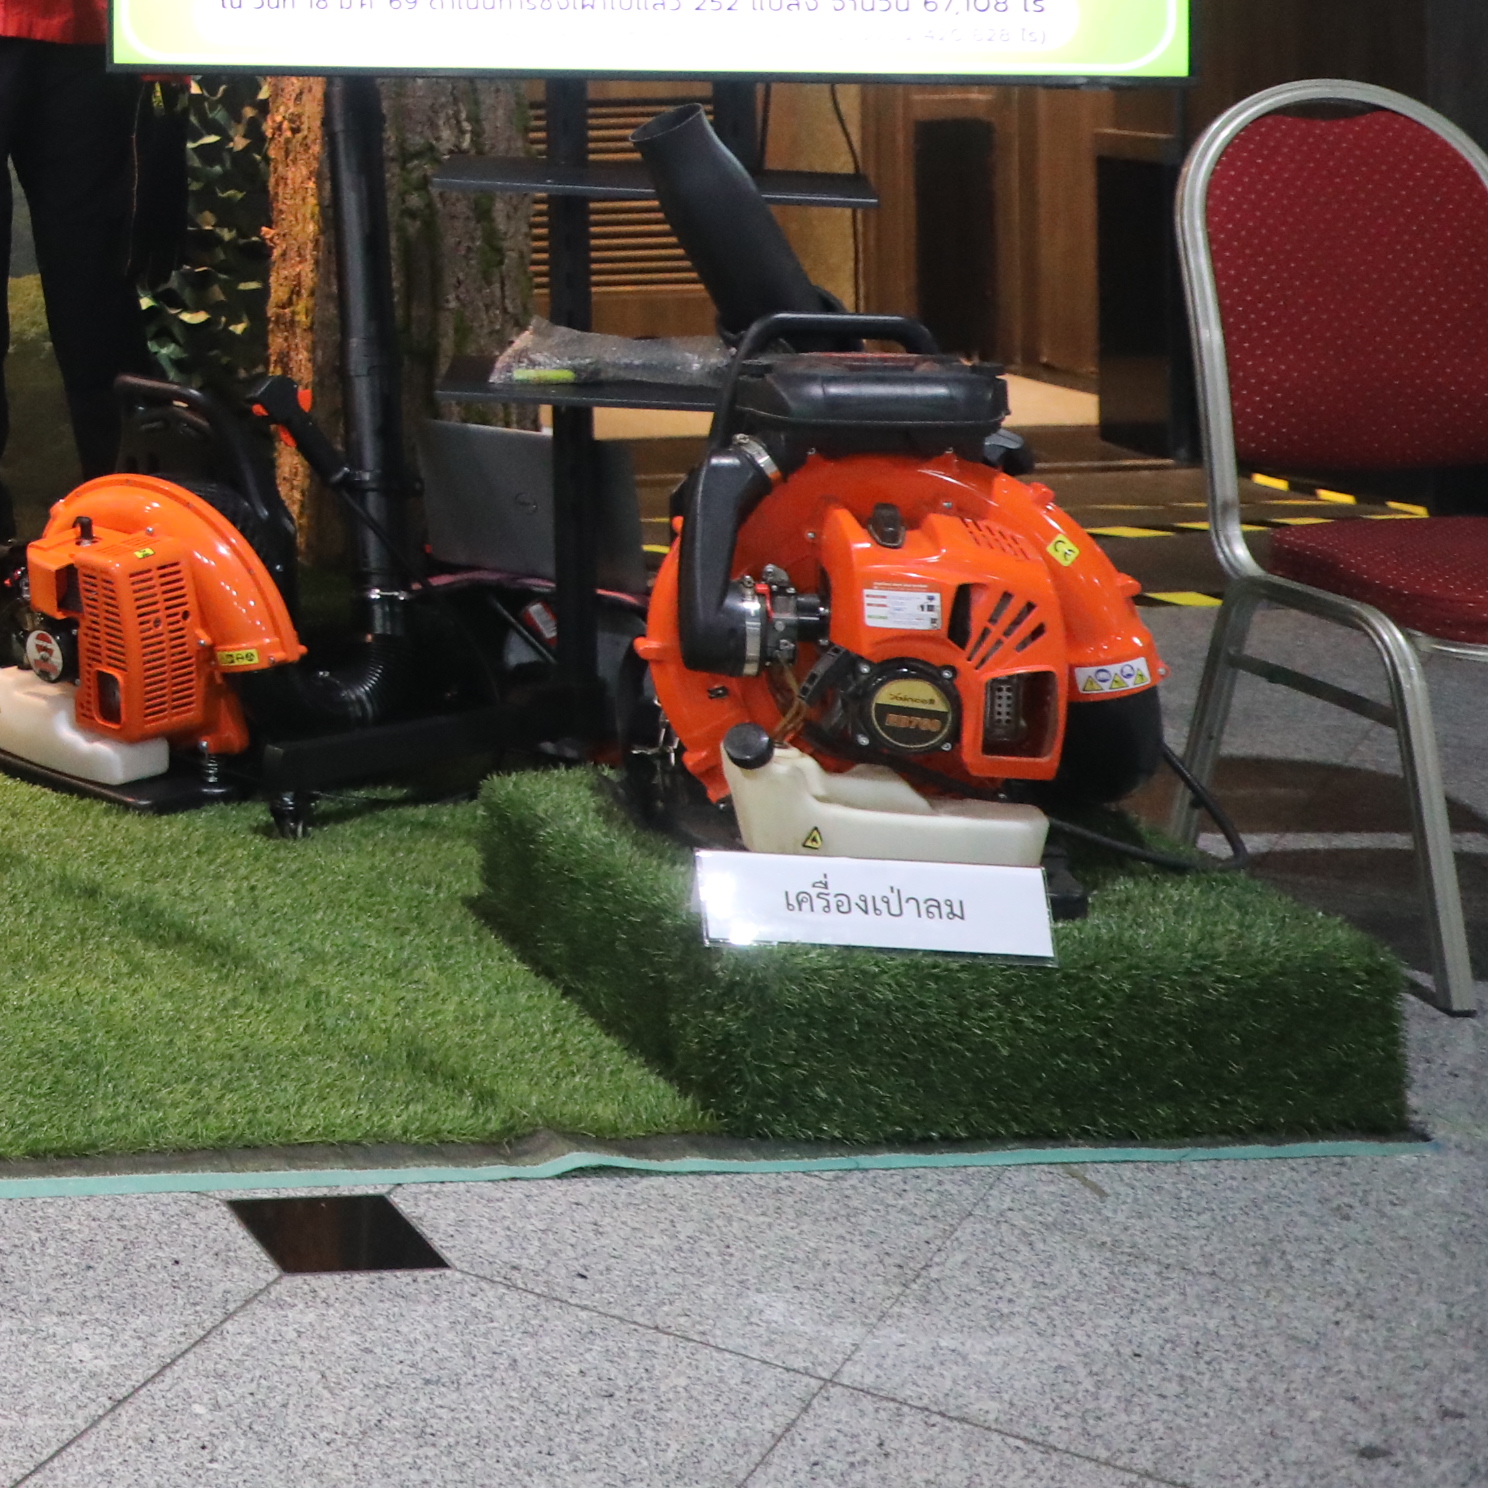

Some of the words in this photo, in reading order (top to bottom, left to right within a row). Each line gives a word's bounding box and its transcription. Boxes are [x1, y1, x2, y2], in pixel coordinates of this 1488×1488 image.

[784, 873, 966, 922] เครื่องเป่าลม
